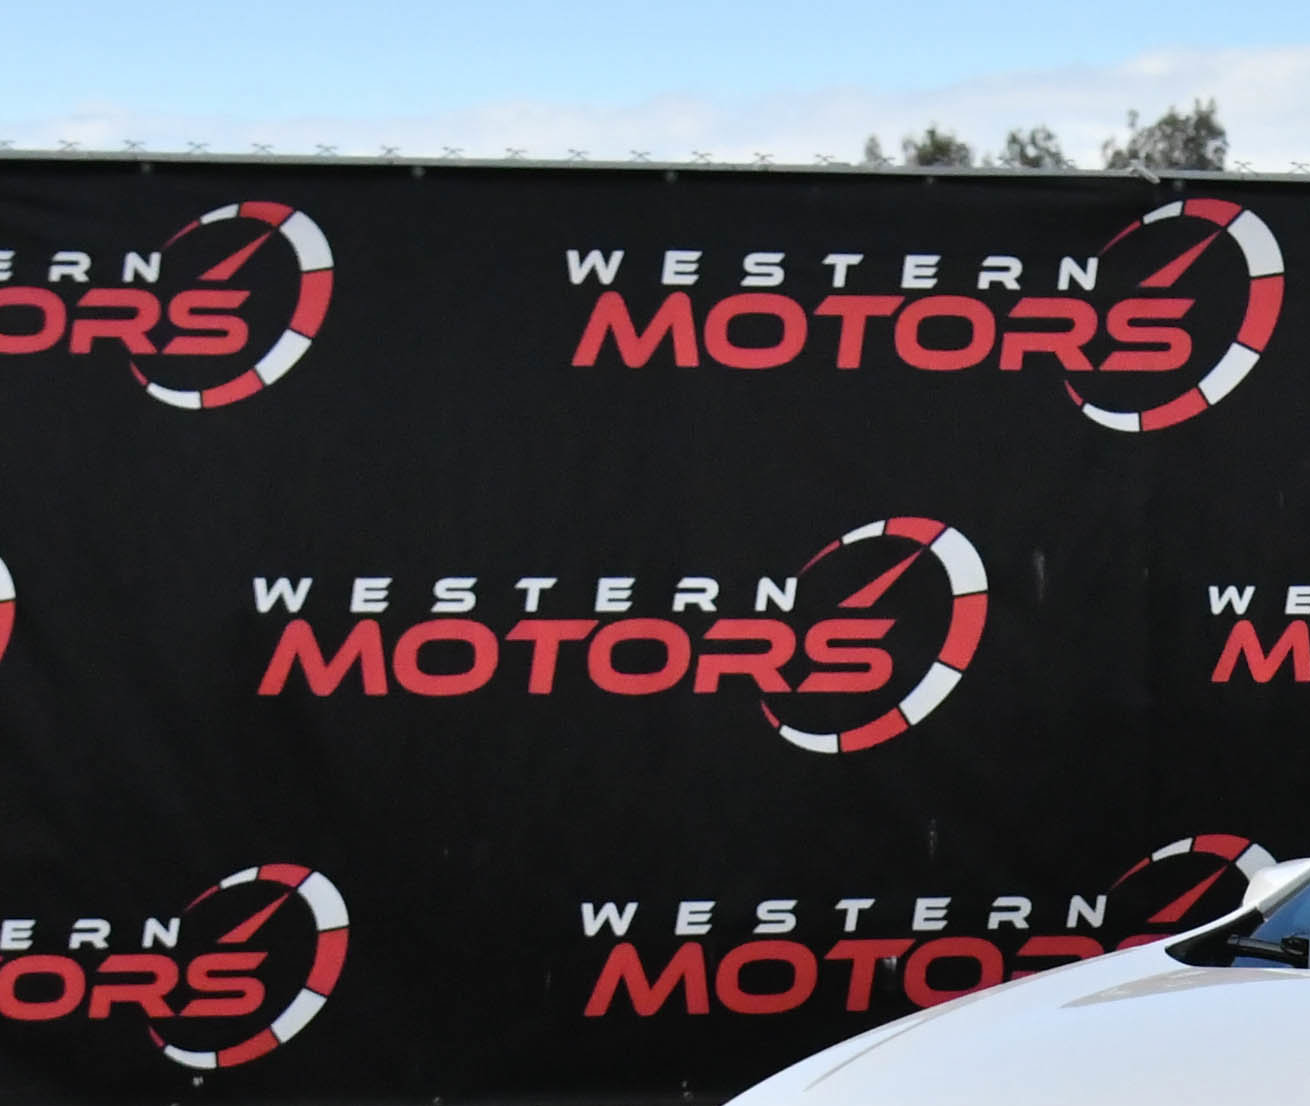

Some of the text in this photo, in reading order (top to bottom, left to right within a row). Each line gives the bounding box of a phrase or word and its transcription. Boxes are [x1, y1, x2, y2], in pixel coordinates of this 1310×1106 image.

[567, 249, 1099, 291] WESTERN
[571, 290, 1196, 372] MOTORS
[253, 576, 798, 613] WESTERN
[257, 617, 897, 697] MOTORS
[0, 917, 181, 950] ERN
[582, 895, 1107, 937] WESTERN
[584, 934, 1169, 1017] MOTO
